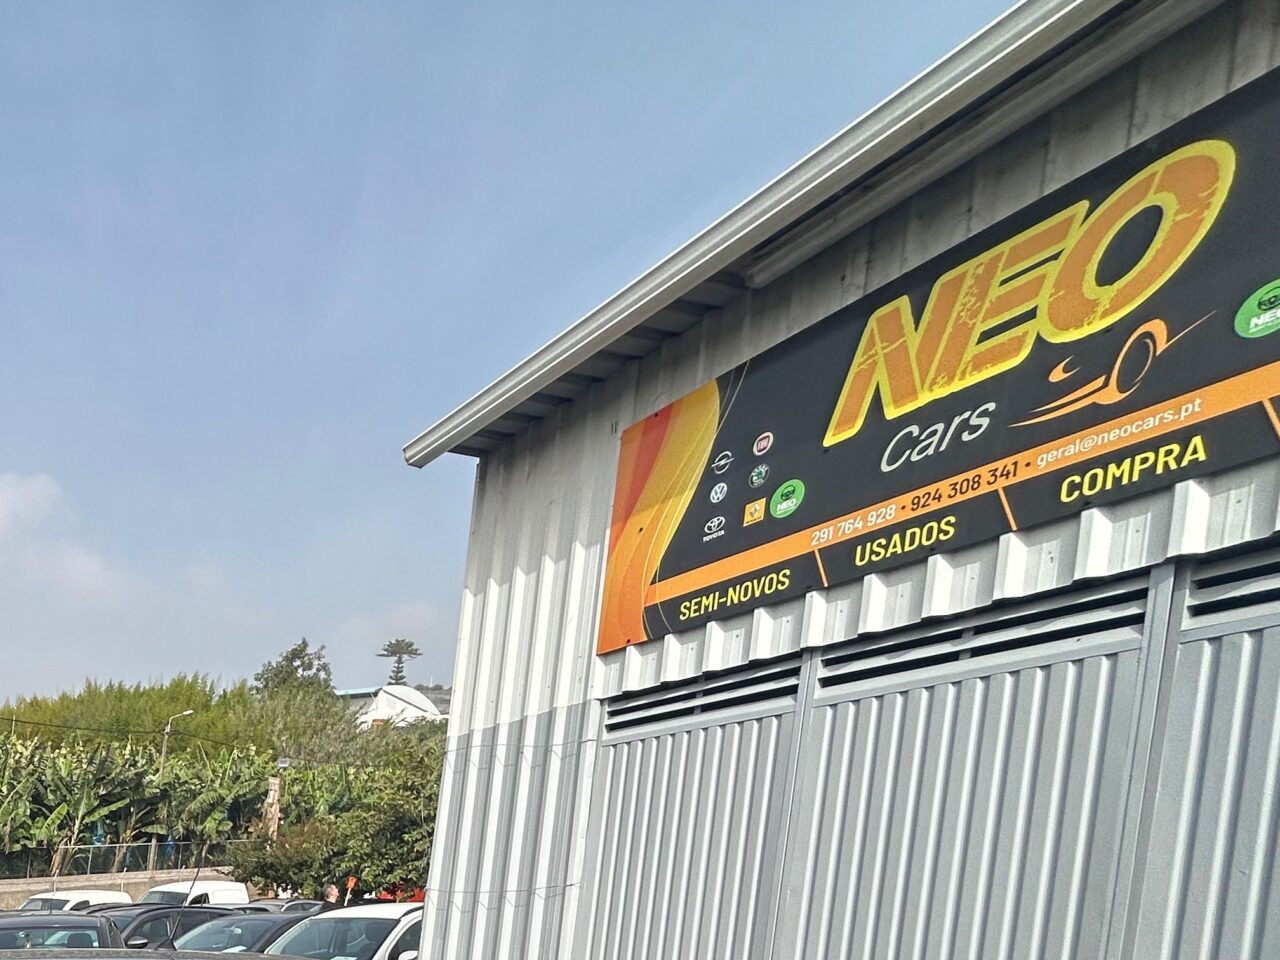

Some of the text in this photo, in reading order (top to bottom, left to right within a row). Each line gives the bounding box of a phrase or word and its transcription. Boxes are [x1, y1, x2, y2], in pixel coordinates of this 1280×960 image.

[823, 139, 1236, 447] NEO
[810, 397, 1202, 546] 291 764 928 924 308 341 geral@neocars.pt
[881, 402, 997, 473] Cars
[1059, 435, 1207, 503] COMPRA
[854, 515, 957, 567] USADOS
[679, 568, 791, 621] SEMI-NOVOS
